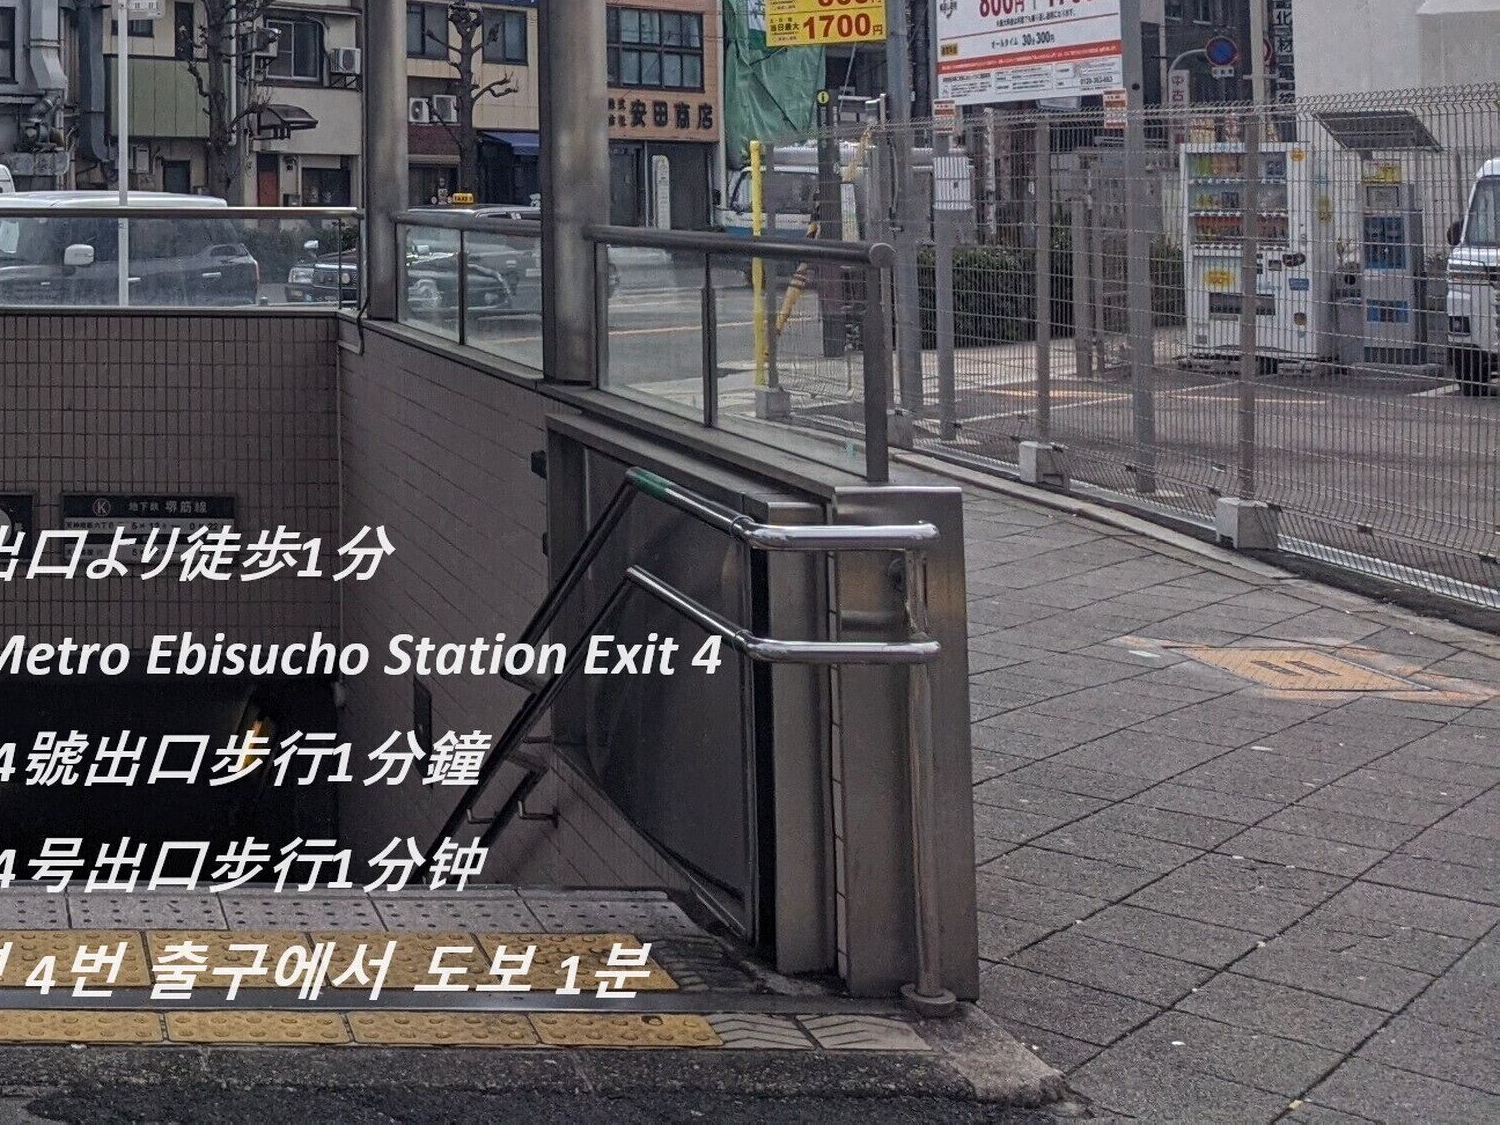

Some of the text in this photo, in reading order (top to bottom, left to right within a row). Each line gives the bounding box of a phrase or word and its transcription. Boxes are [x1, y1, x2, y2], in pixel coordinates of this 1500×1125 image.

[803, 13, 883, 40] 1700円
[630, 99, 713, 130] 安田商店
